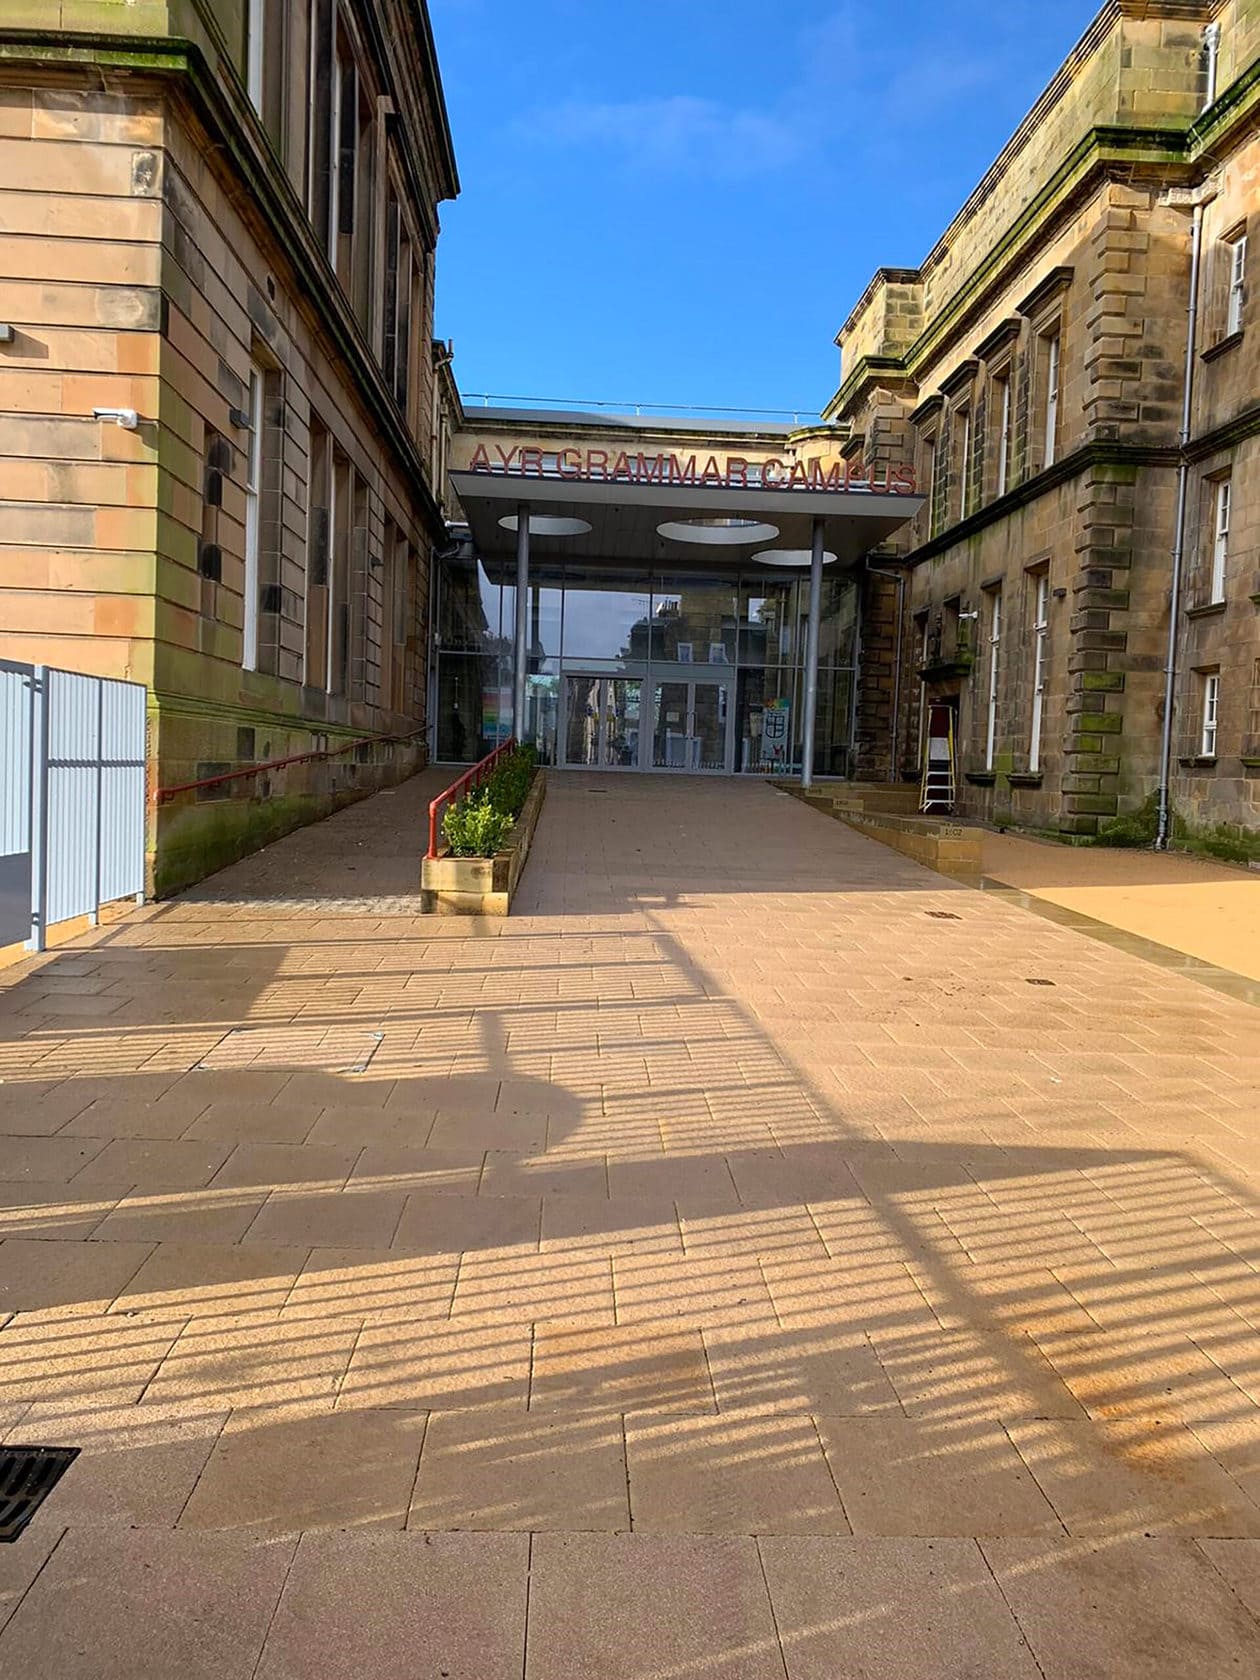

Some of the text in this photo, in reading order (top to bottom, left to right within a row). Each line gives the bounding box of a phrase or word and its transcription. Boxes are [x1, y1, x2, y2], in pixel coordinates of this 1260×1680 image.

[469, 443, 917, 495] AYR GRAMMAR CAMPUS
